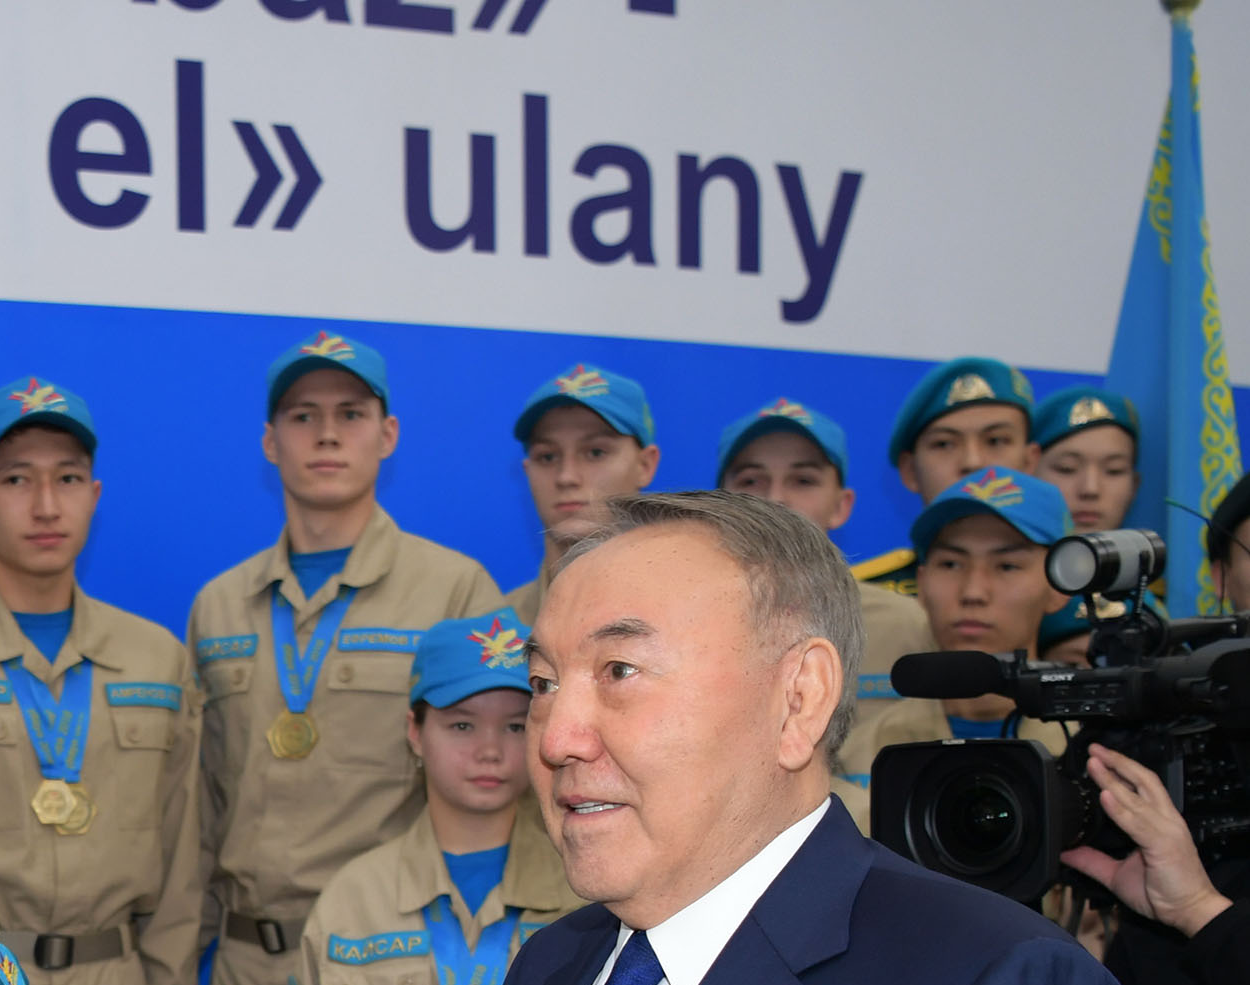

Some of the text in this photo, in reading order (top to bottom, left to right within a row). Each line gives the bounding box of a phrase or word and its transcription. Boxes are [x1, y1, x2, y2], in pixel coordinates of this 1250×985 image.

[47, 58, 324, 233] el»
[403, 93, 864, 325] ulany
[1041, 673, 1075, 682] SONY
[333, 936, 423, 961] КАЙСАР
